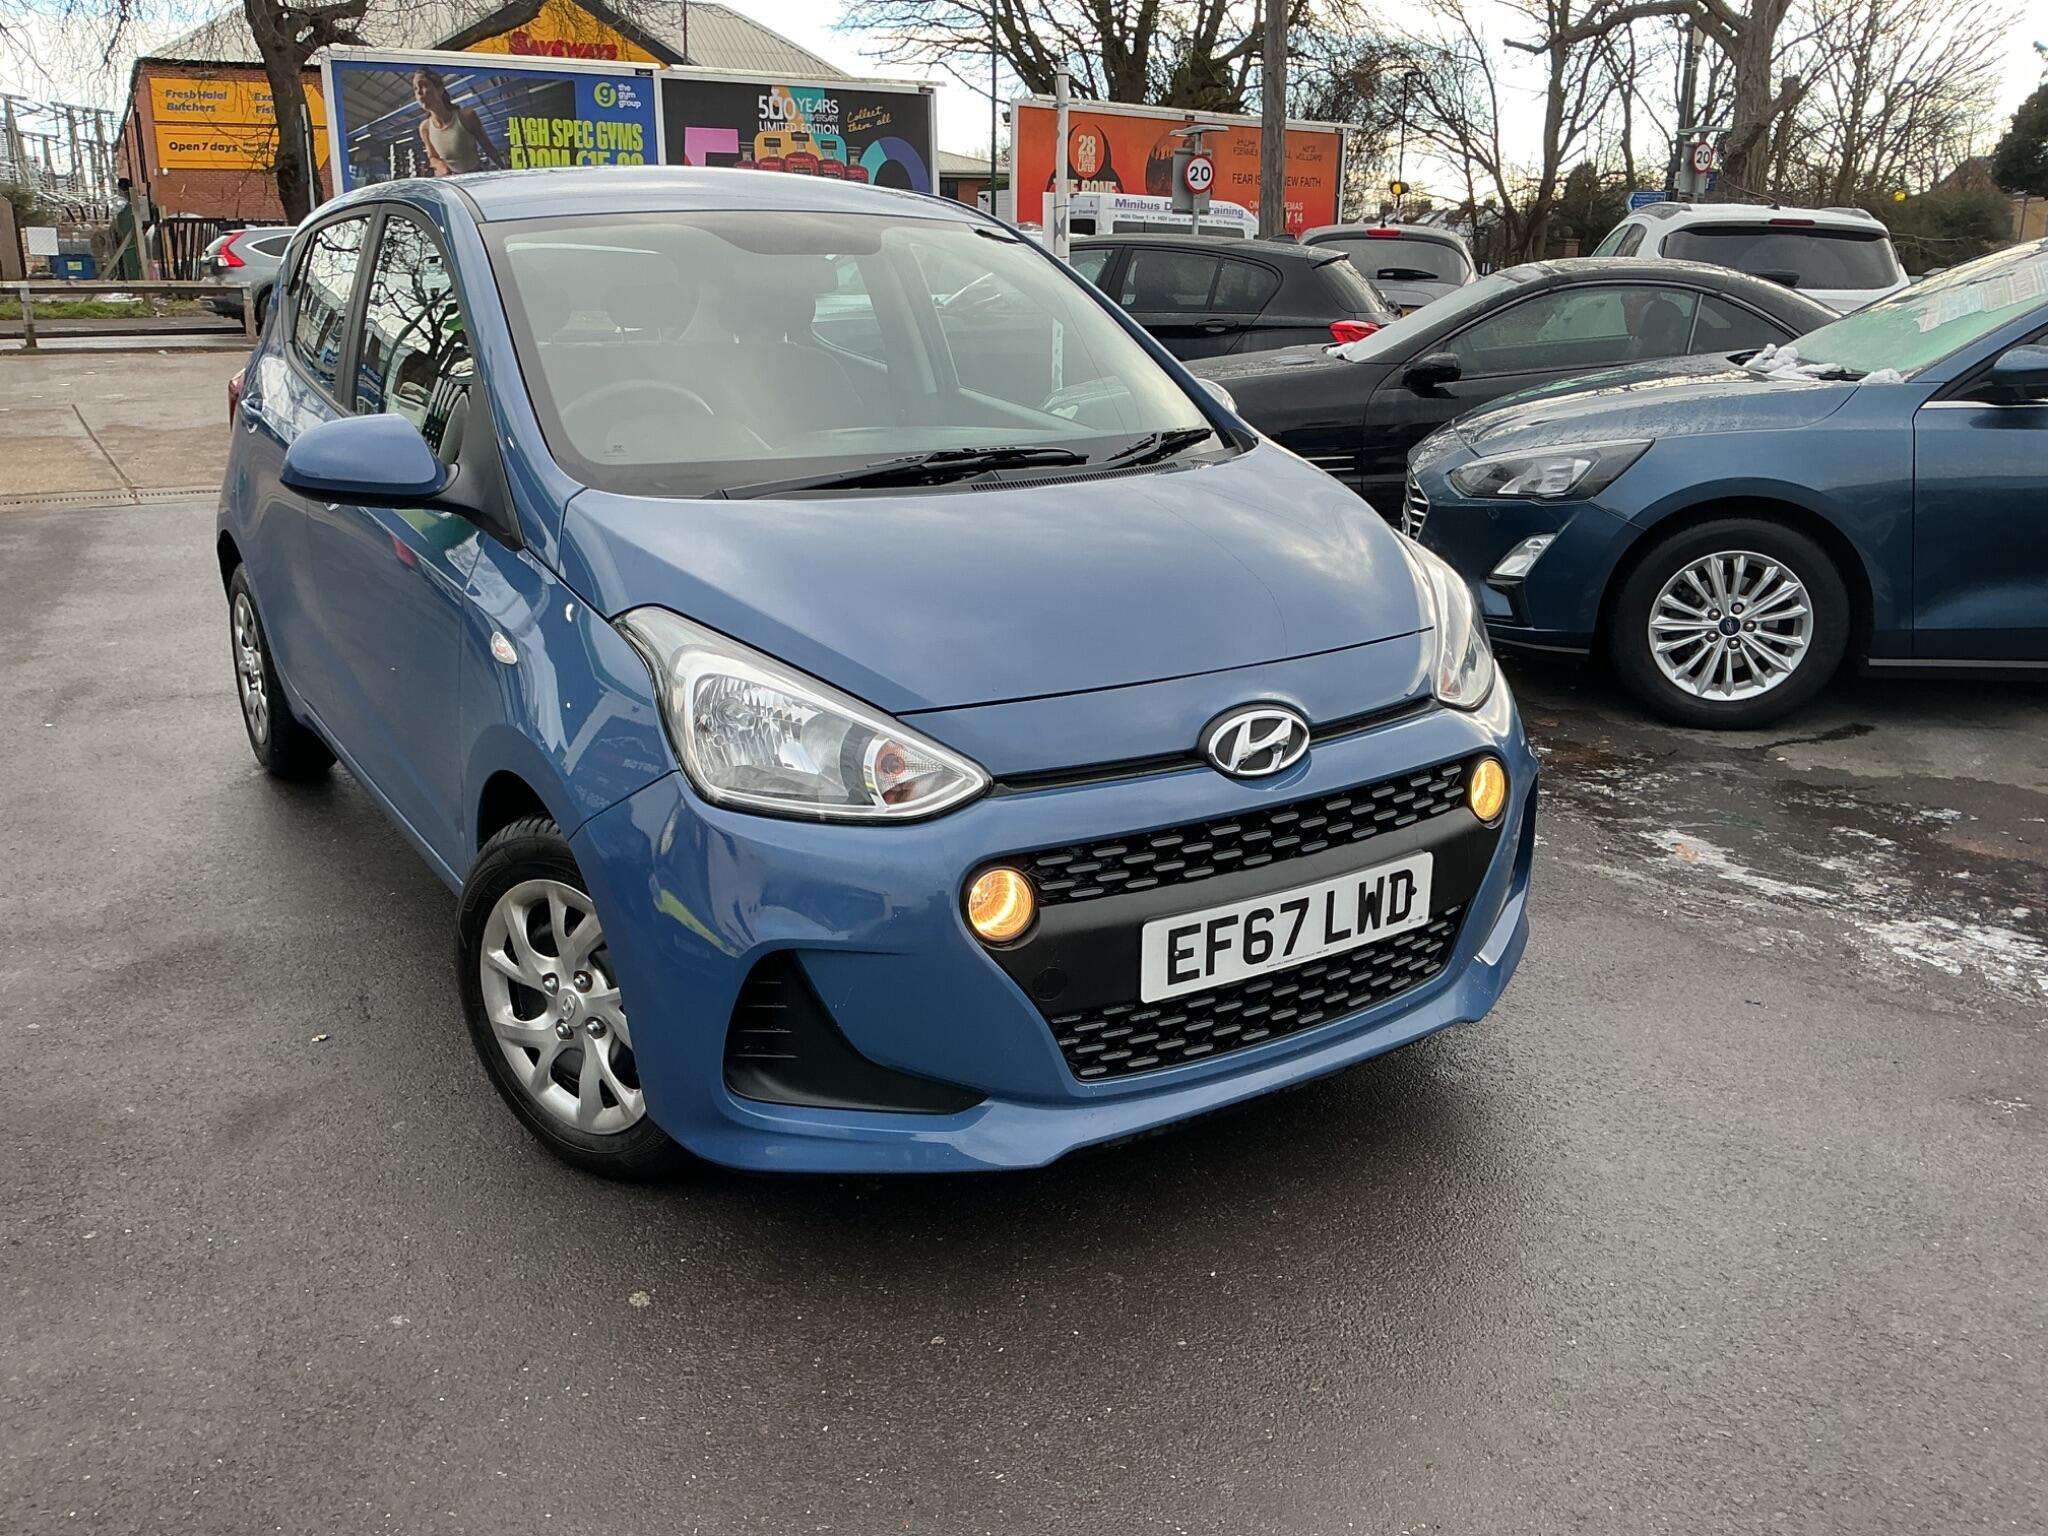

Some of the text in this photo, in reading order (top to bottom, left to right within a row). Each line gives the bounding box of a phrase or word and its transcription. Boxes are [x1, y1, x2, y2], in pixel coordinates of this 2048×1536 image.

[165, 89, 227, 100] Fresh Halal
[618, 83, 631, 92] the
[618, 91, 636, 100] gym
[167, 102, 216, 113] Butchers
[618, 99, 642, 109] group
[797, 97, 839, 114] YEARS
[847, 105, 883, 123] Collect
[876, 113, 893, 127] all
[508, 117, 644, 151] HIGH SPEC GYMS
[758, 121, 839, 135] LIMITED EDITION
[169, 141, 200, 153] Open
[202, 142, 208, 151] 7
[210, 142, 238, 153] days
[1078, 134, 1096, 154] 28
[1696, 151, 1710, 164] 20
[1189, 166, 1211, 182] 20
[1232, 172, 1253, 184] FEAR
[1300, 178, 1322, 188] FAITH
[1114, 199, 1160, 210] Minibus
[1208, 205, 1244, 219] raining
[1294, 211, 1303, 224] 14
[1167, 868, 1415, 986] EF67 LWD
